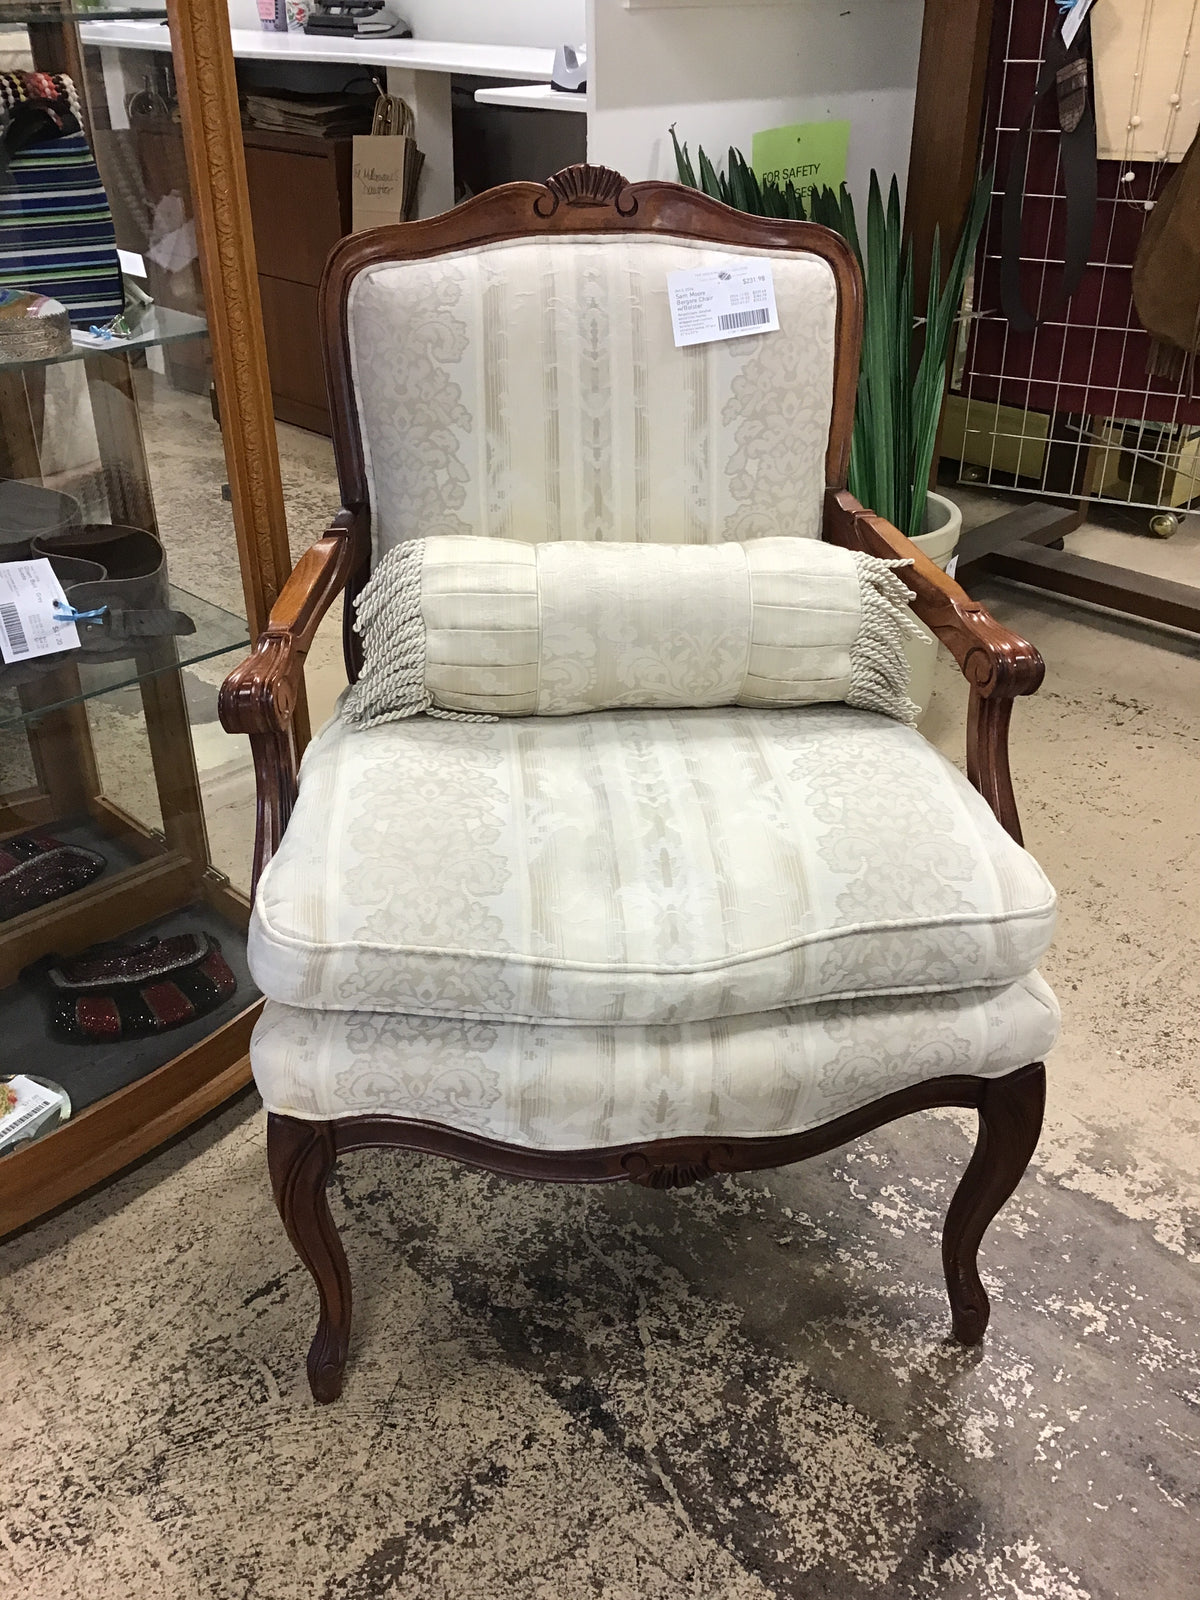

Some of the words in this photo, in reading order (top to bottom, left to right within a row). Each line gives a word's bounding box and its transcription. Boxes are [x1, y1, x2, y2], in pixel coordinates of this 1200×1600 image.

[762, 170, 780, 183] FOR
[782, 163, 821, 180] SAFETY
[742, 275, 766, 285] $231.98
